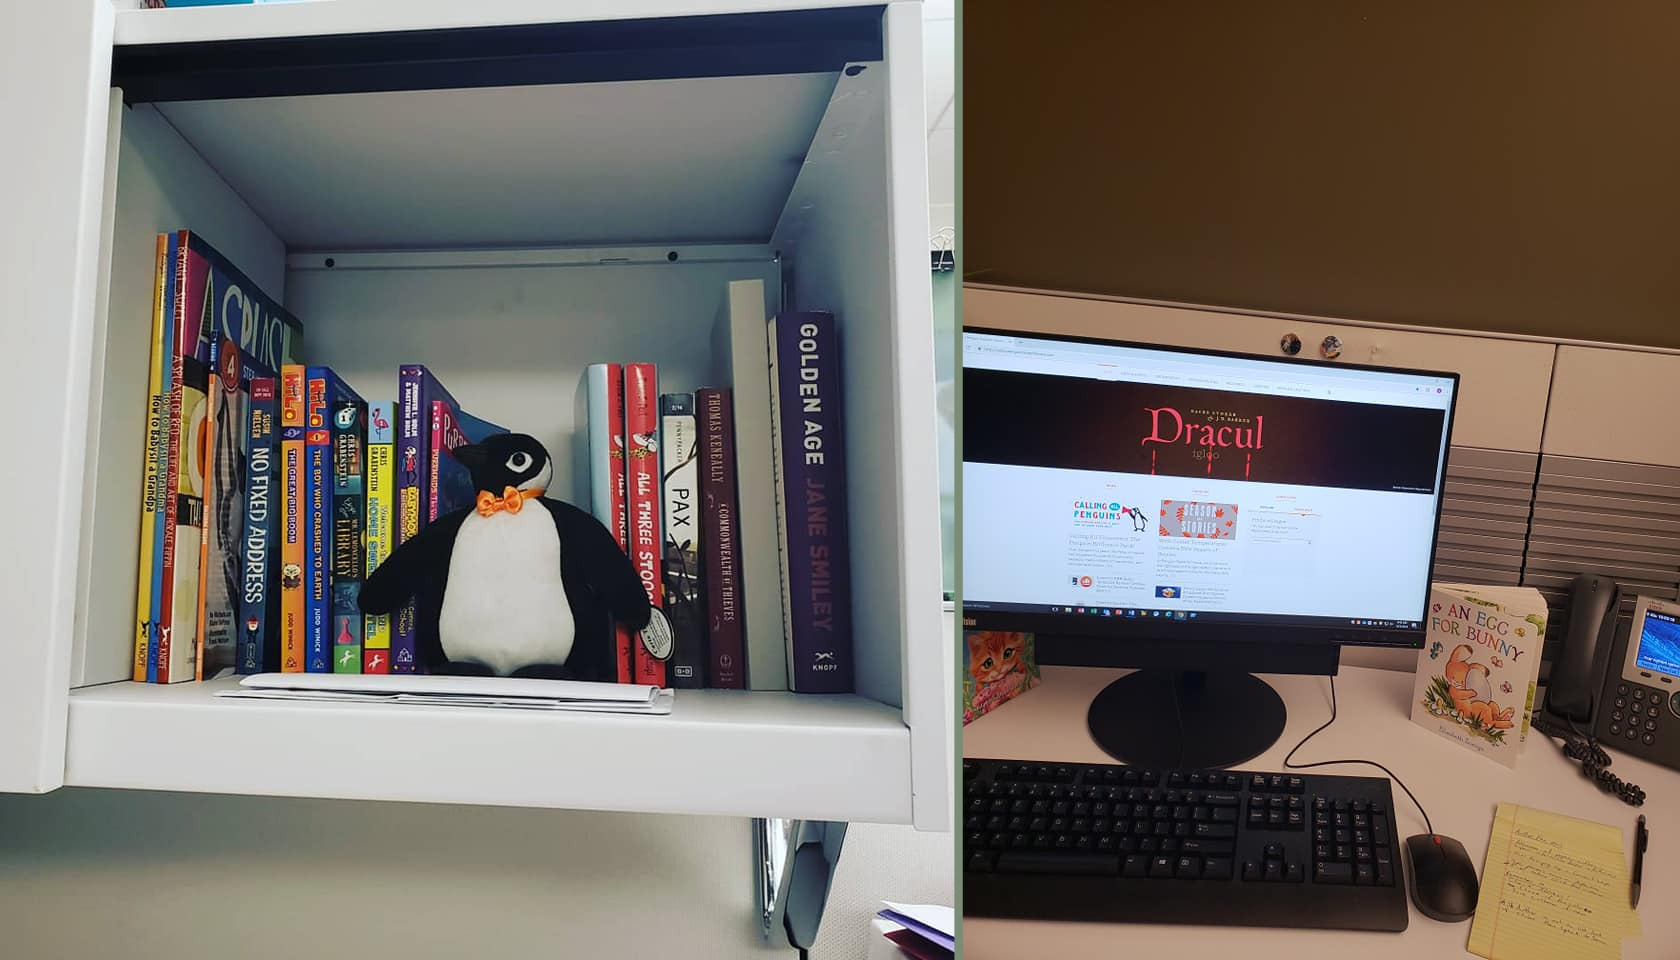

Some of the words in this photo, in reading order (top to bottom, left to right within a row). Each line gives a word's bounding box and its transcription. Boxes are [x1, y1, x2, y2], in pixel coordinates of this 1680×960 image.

[173, 355, 182, 363] A
[227, 355, 235, 378] 4
[798, 323, 822, 413] GOLDEN
[171, 365, 182, 402] SPLASH
[152, 395, 162, 415] How
[163, 392, 171, 411] How
[171, 403, 181, 415] OF
[708, 393, 721, 432] THOMAS
[151, 418, 161, 427] to
[162, 414, 171, 424] to
[1142, 407, 1263, 449] Dracul
[149, 430, 161, 464] Babysit
[160, 427, 170, 461] Babysit
[169, 439, 178, 452] THE
[347, 434, 356, 457] CHRIS
[803, 420, 824, 465] AGE
[168, 454, 178, 469] LIFE
[251, 447, 270, 471] NO
[288, 449, 297, 468] THE
[313, 449, 322, 467] THE
[339, 434, 347, 487] GRABENSTEIN
[370, 447, 378, 492] GRABENSTEIN
[380, 447, 388, 466] CHRIS
[710, 434, 724, 483] KENEALLY
[167, 471, 177, 487] AND
[288, 469, 297, 498] GREAT
[313, 469, 322, 486] BOY
[637, 472, 651, 496] ALL
[145, 475, 156, 513] Grandpa
[157, 472, 167, 513] Grandma
[166, 489, 176, 504] ART
[249, 474, 269, 522] FIXED
[313, 488, 322, 510] WHO
[1074, 501, 1107, 510] CALLING
[166, 506, 175, 515] OF
[288, 499, 297, 515] BIG
[369, 497, 378, 537] HOME
[672, 488, 690, 527] PAX
[806, 478, 827, 537] JANE
[1073, 510, 1121, 520] PENGUINS
[1183, 503, 1217, 518] SEASON
[164, 517, 175, 545] HORACE
[287, 516, 296, 544] BOOM
[314, 511, 322, 554] CRASHED
[638, 501, 654, 546] THREE
[1181, 520, 1217, 534] STORIES
[337, 519, 351, 577] LIBRARY
[719, 509, 733, 576] COMMONWEALTH
[244, 525, 267, 603] ADDRESS
[314, 556, 322, 568] TO
[314, 570, 322, 600] EARTH
[809, 544, 832, 632] SMILEY
[722, 587, 735, 622] THIEVES
[1448, 603, 1471, 621] AN
[1475, 610, 1510, 636] EGG
[1431, 617, 1460, 637] FOR
[1466, 625, 1525, 662] BUNNY
[138, 642, 146, 667] KNOPF
[158, 647, 167, 671] KNOPF
[812, 664, 838, 672] KNOPF
